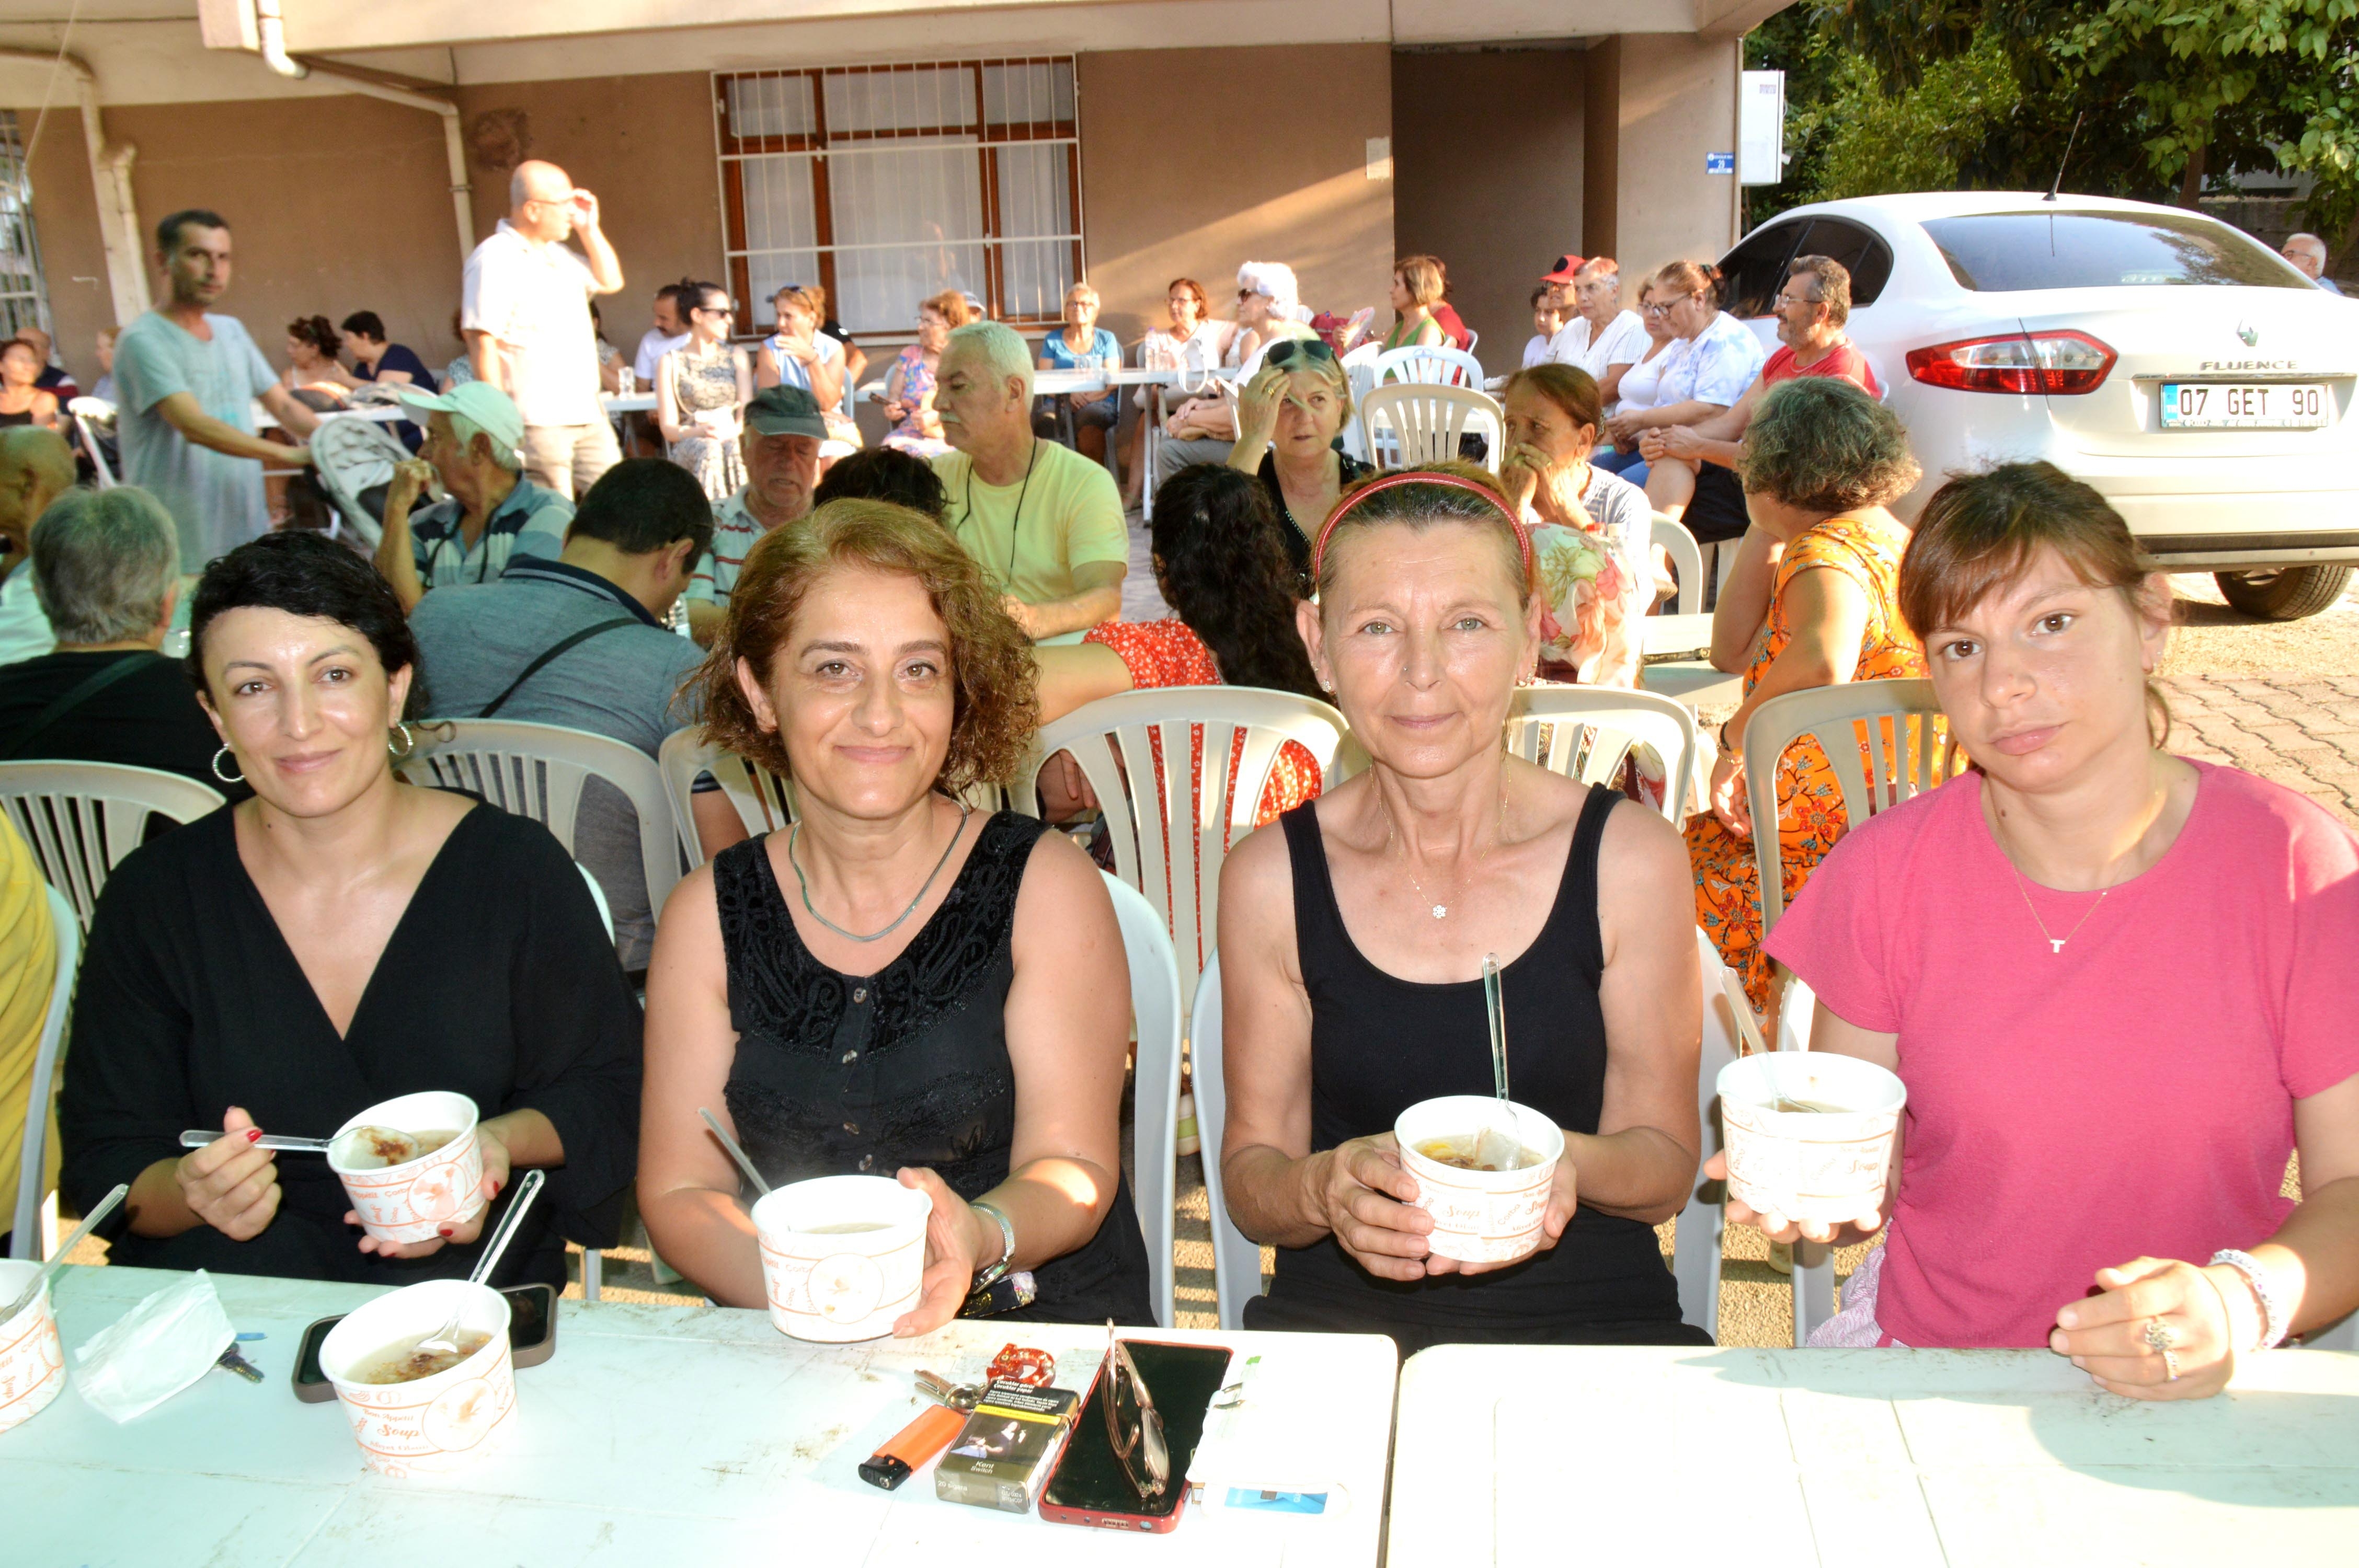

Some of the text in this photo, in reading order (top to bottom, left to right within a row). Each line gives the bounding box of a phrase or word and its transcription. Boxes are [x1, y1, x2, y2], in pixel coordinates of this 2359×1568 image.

[2200, 361, 2297, 371] FLUENCE
[2180, 388, 2318, 416] 07 GET 90
[377, 1424, 420, 1439] Soup
[970, 1466, 993, 1474] Switch
